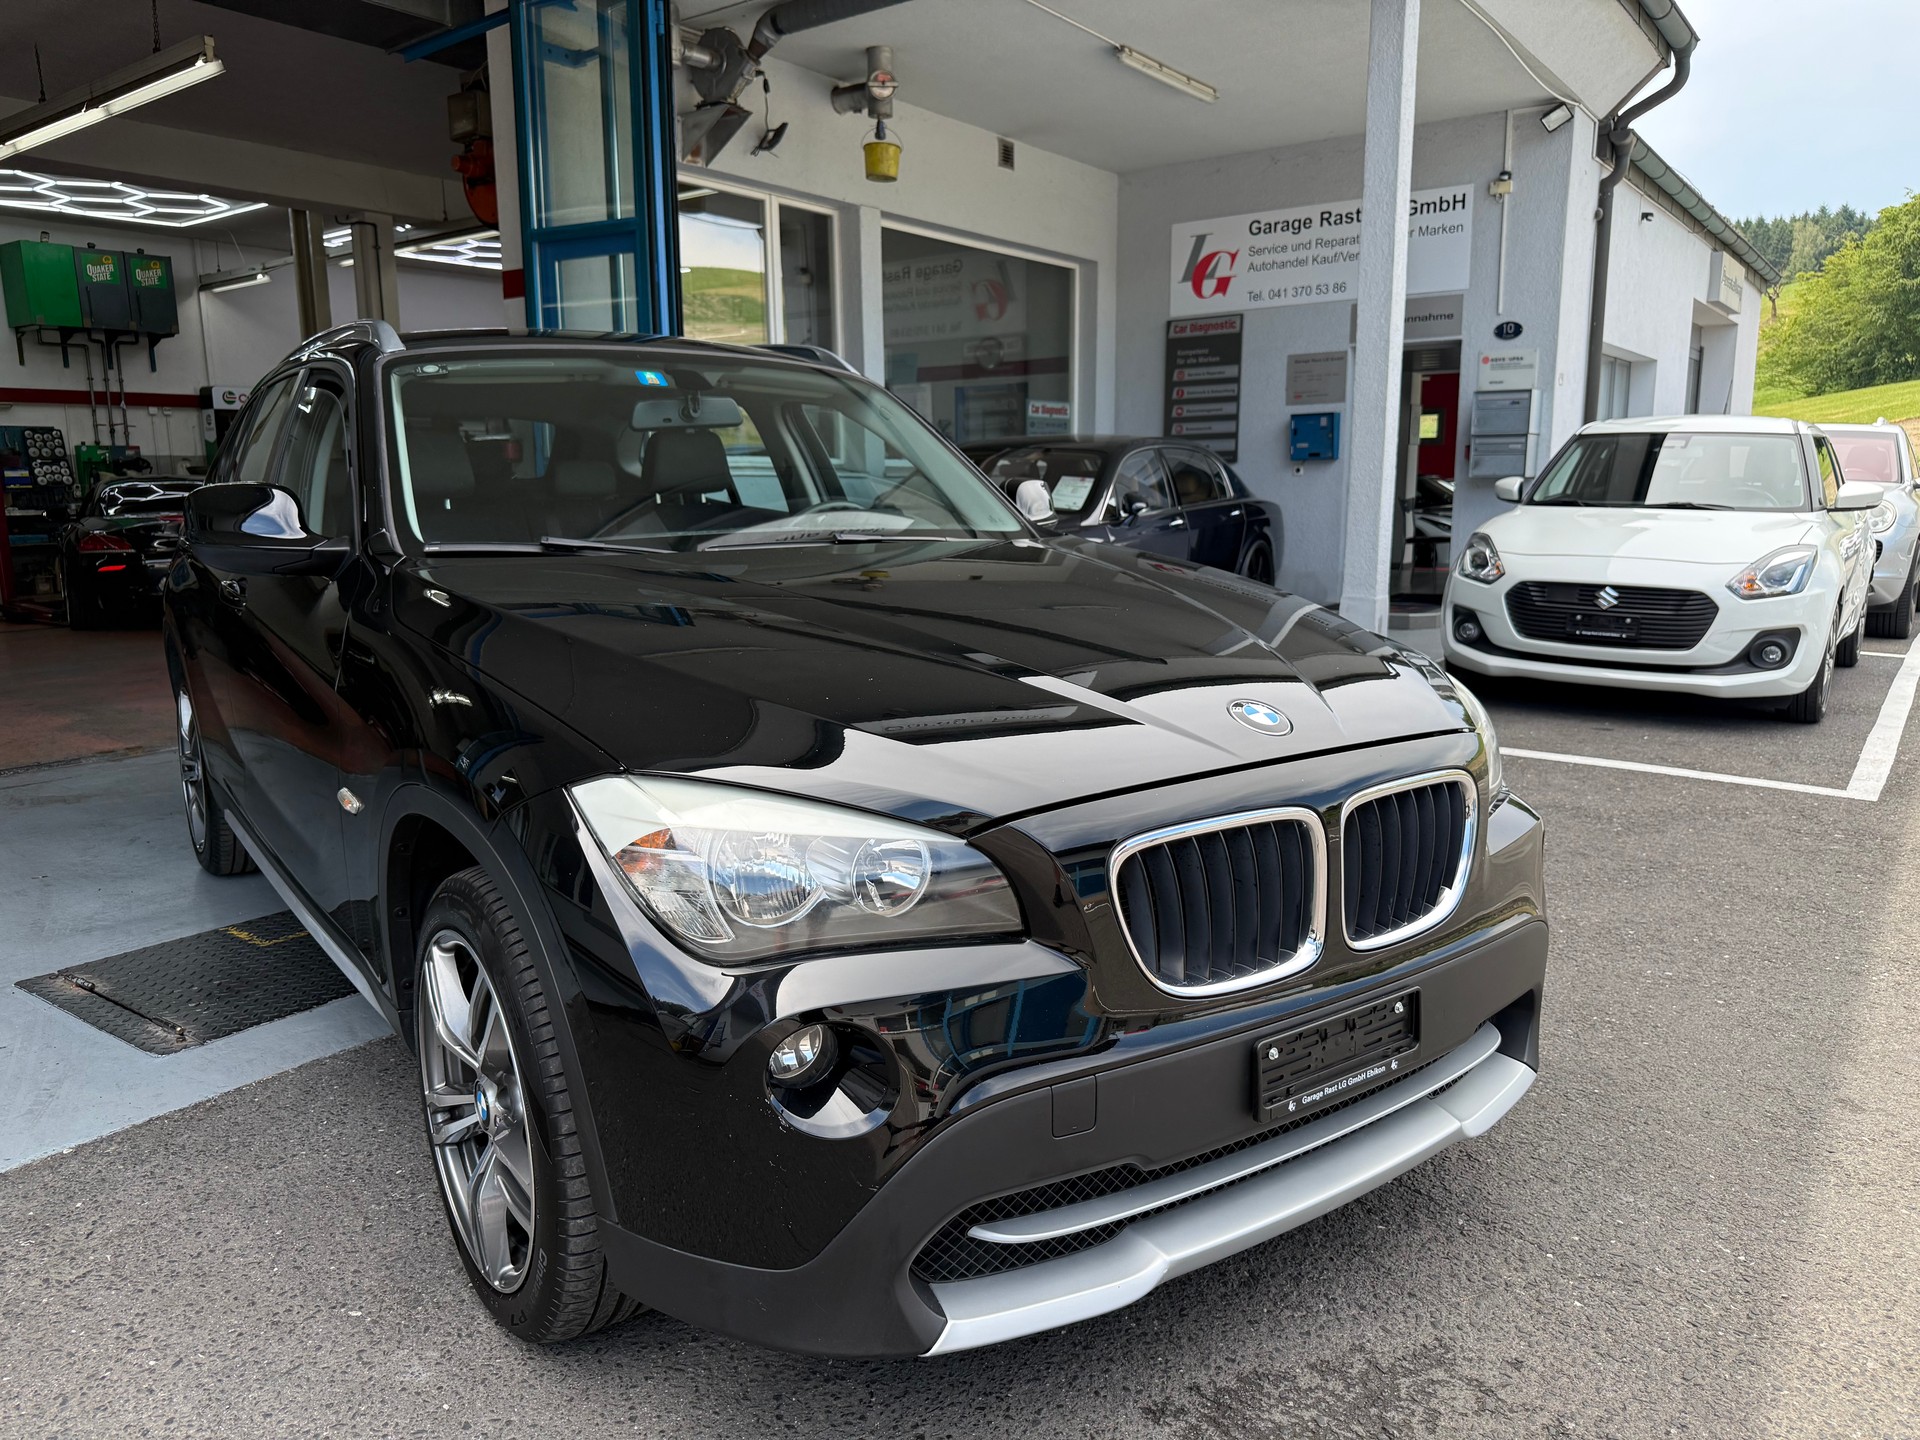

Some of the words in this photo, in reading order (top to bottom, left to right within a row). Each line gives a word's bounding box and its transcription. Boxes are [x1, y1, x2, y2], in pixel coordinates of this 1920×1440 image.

[1248, 217, 1312, 236] Garage
[1320, 207, 1361, 227] Rast
[1248, 243, 1288, 257] Service
[1291, 240, 1311, 252] und
[1315, 234, 1360, 250] Reparat
[1418, 223, 1464, 237] Marken
[1247, 256, 1308, 273] Autohandel
[1311, 251, 1360, 266] Kauf/Ver
[86, 264, 114, 277] QUAKER
[92, 272, 111, 282] STATE
[135, 269, 161, 281] QUAKER
[1247, 291, 1265, 302] Tel.
[1268, 289, 1287, 301] 041
[1292, 285, 1311, 297] 370
[1315, 284, 1329, 295] 53
[1332, 282, 1347, 294] 86
[1405, 312, 1454, 324] nnahme
[1173, 325, 1187, 335] Car
[1189, 320, 1237, 335] Diagnostic
[1503, 323, 1515, 334] 10
[1302, 1092, 1323, 1104] Garage
[1324, 1085, 1338, 1096] Rast
[1338, 1080, 1347, 1090] LG
[1347, 1072, 1366, 1085] GmbH
[1367, 1065, 1386, 1078] Ebikon
